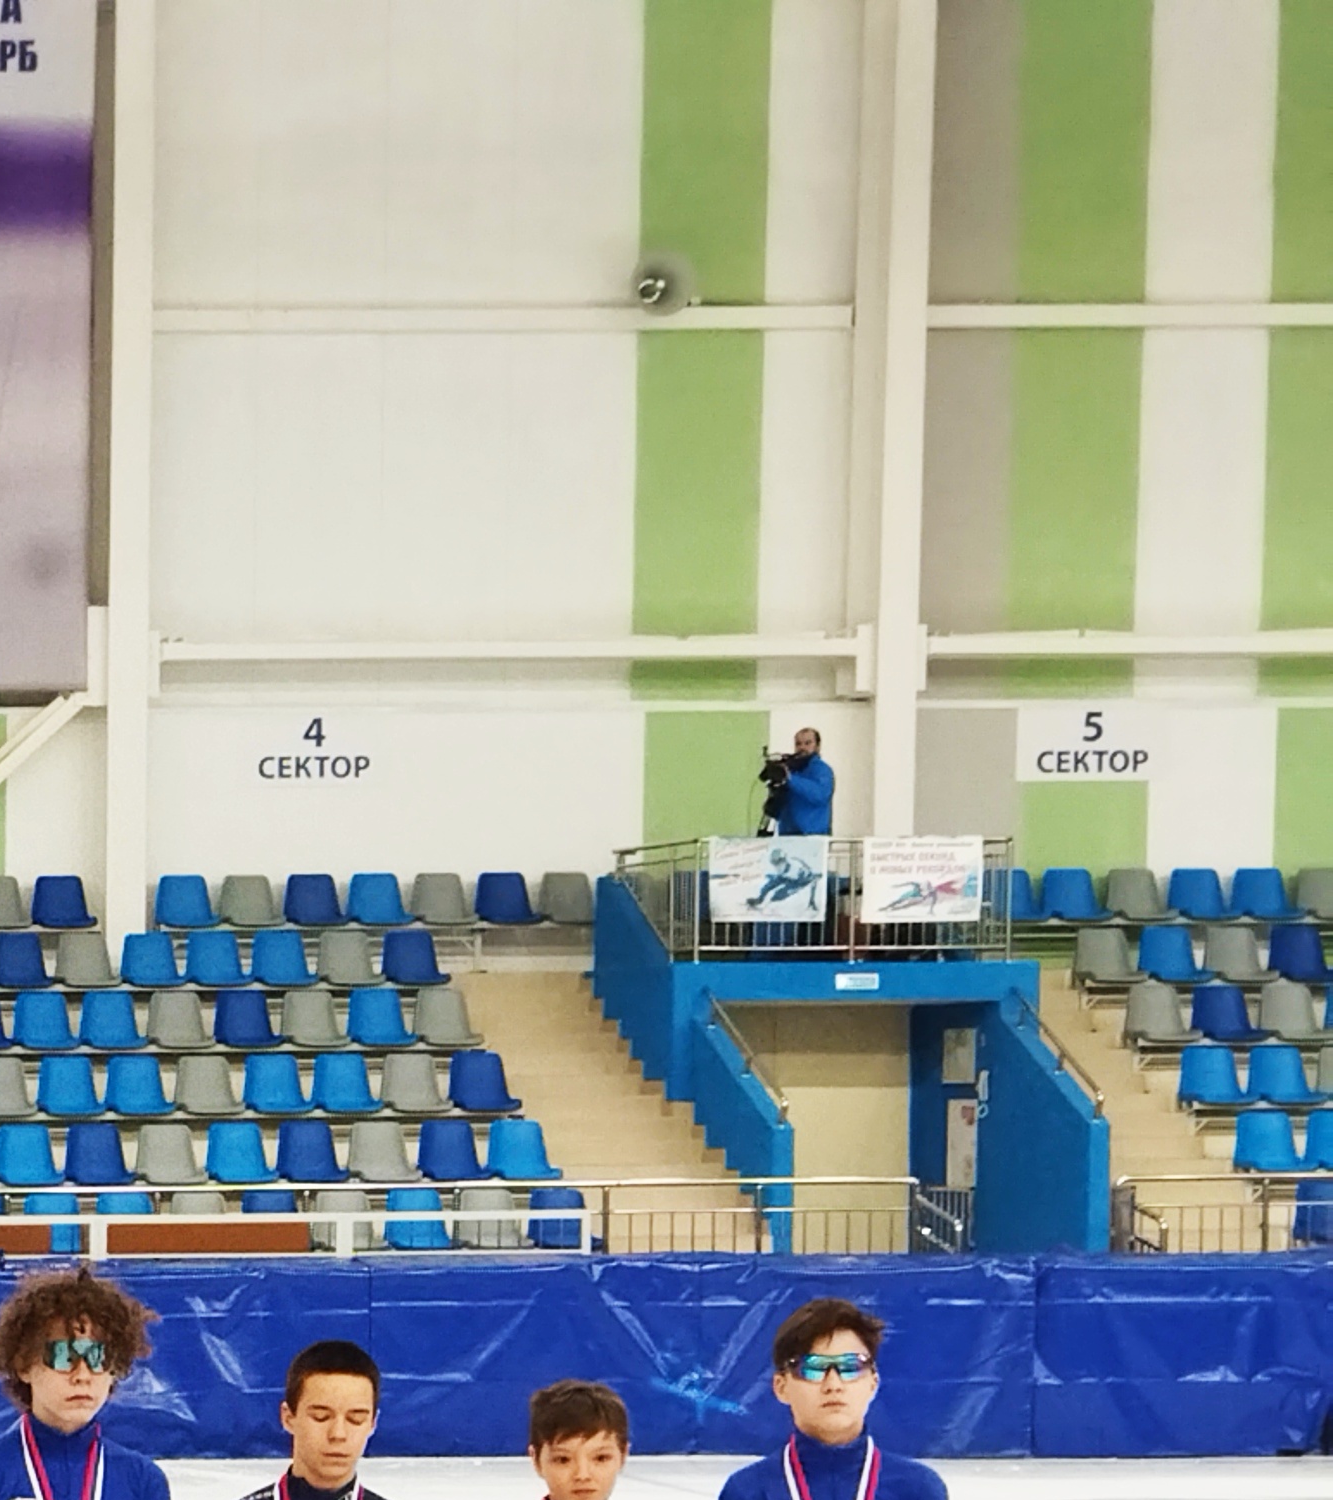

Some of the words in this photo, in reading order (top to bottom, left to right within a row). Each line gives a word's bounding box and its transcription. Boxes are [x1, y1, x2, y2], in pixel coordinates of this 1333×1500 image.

[0, 40, 38, 73] РБ
[302, 717, 326, 747] 4
[1082, 711, 1103, 742] 5
[258, 755, 370, 779] СЕКТОР
[1037, 750, 1149, 773] СЕКТОР
